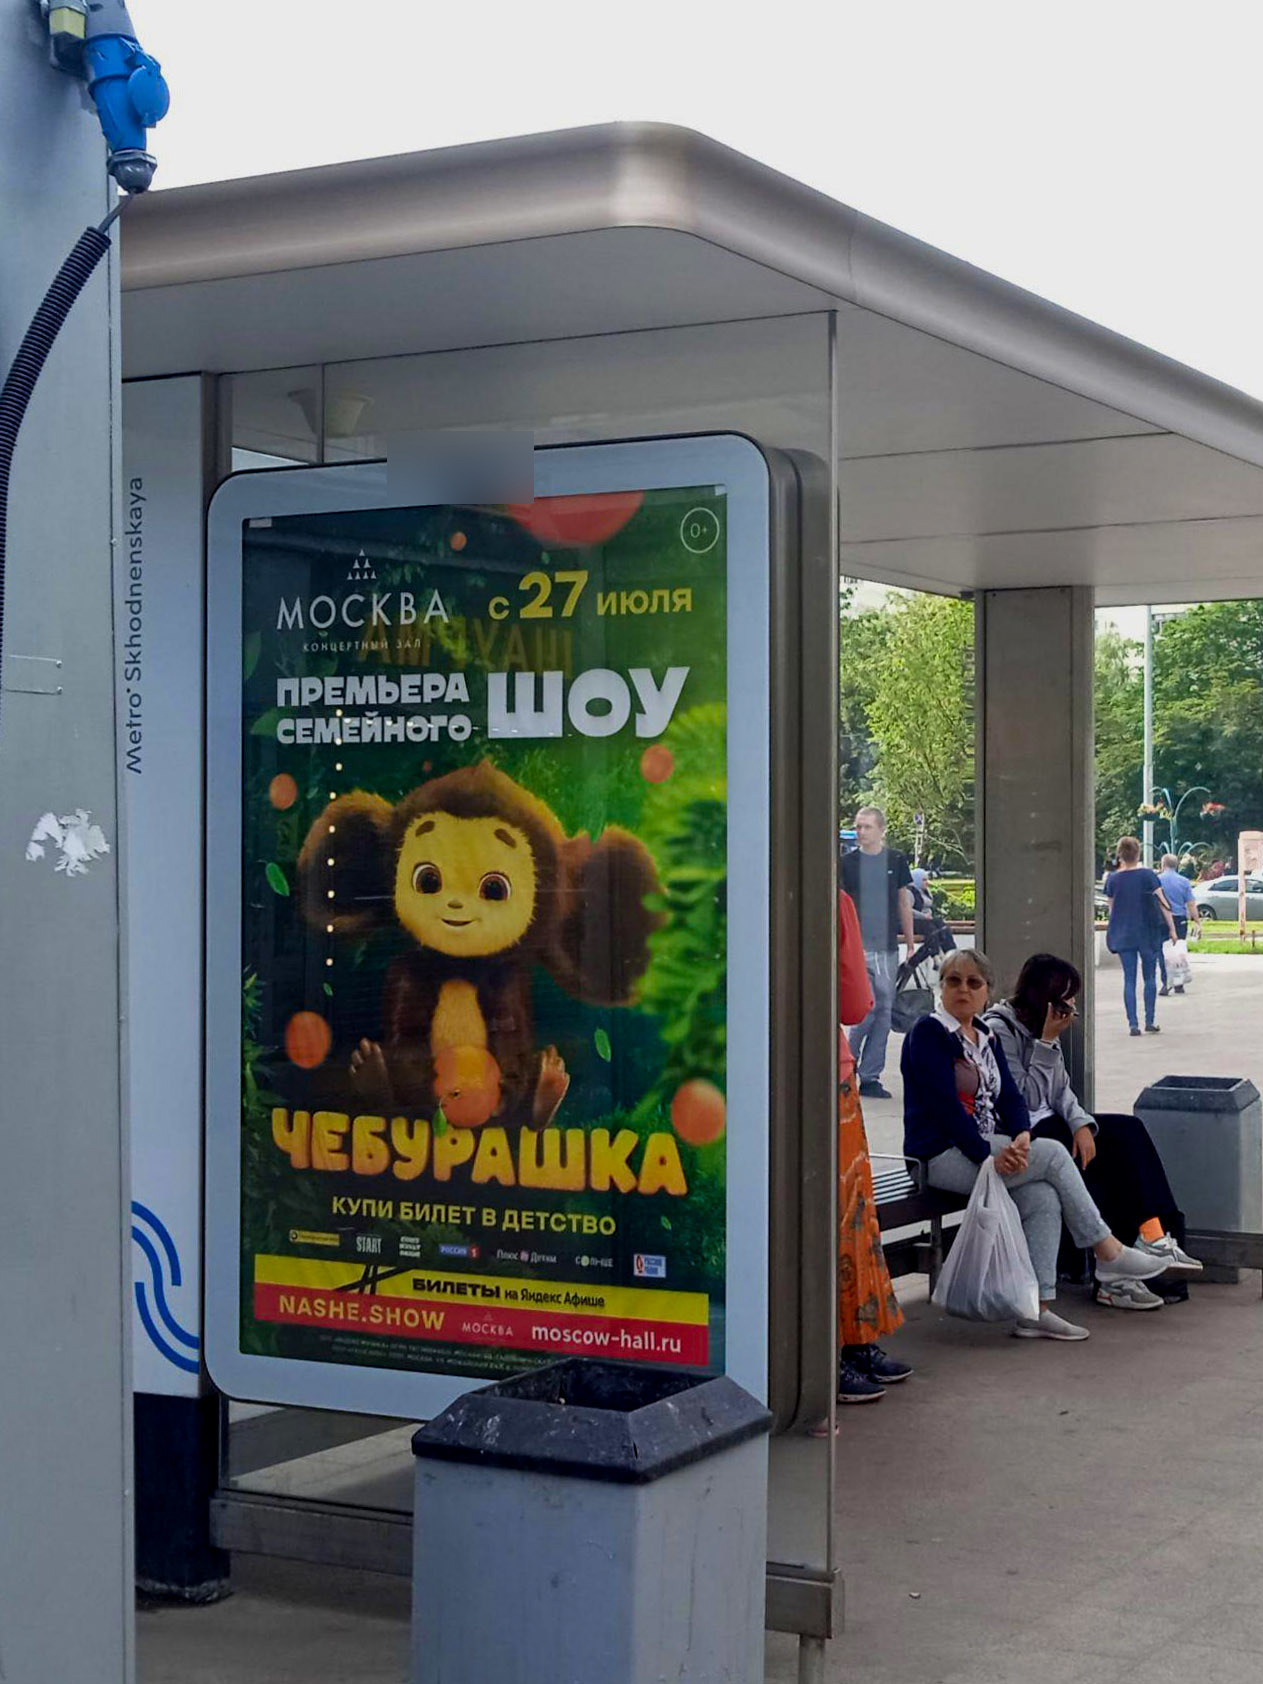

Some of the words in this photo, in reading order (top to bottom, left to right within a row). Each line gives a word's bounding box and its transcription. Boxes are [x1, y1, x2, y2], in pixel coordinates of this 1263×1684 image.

[689, 522, 709, 539] 0+
[124, 476, 147, 682] Skhodnenskaya
[518, 570, 589, 619] 27
[276, 589, 450, 630] МОСКВА
[303, 639, 389, 653] КОНЦЕРТНЫЙ
[396, 637, 422, 651] ЗАЛ
[276, 672, 470, 707] ПРЕМЬЕРА
[487, 665, 691, 740] ШОУ
[125, 692, 143, 775] Metro
[276, 711, 472, 745] СЕМЕЙНОГО
[270, 1107, 688, 1195] ЧЕБУРАШКА
[332, 1196, 393, 1219] КУПИ
[400, 1201, 476, 1226] БИЛЕТ
[482, 1208, 497, 1227] В
[502, 1209, 616, 1236] ДЕТСТВО
[356, 1236, 383, 1254] START
[412, 1278, 500, 1299] БИЛЕТЫ
[505, 1288, 518, 1300] на
[520, 1287, 562, 1304] Яндекс
[279, 1295, 444, 1332] NASHE.SHOW
[462, 1321, 514, 1338] МОСКВА
[531, 1321, 682, 1354] moscow-hall.ru
